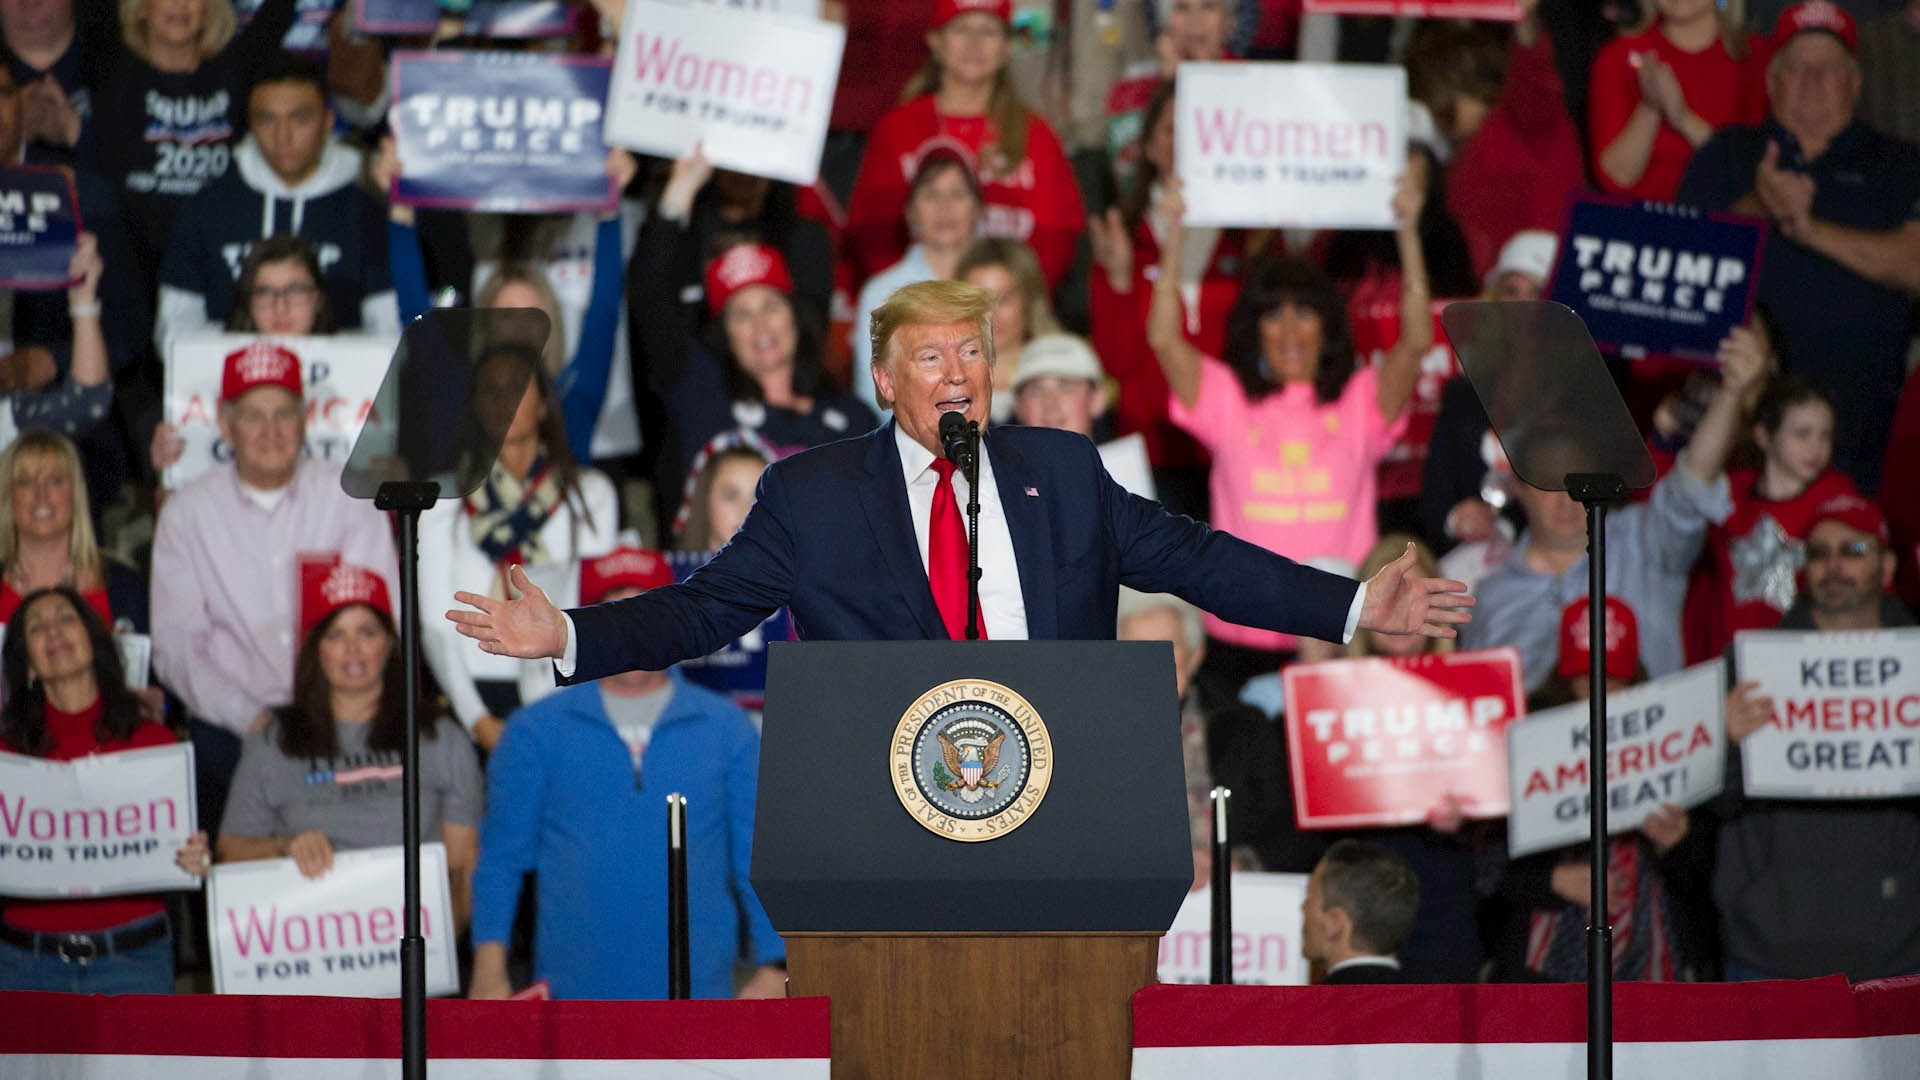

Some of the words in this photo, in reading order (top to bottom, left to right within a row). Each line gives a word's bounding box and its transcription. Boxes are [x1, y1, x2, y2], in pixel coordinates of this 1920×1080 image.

[635, 32, 813, 114] Women
[408, 92, 601, 129] TRUMP
[427, 128, 582, 153] PENCE
[1194, 106, 1389, 161] Women
[155, 142, 229, 178] 2020
[1573, 235, 1746, 291] TRUMP
[1579, 269, 1724, 313] PENCE
[1801, 657, 1901, 688] KEEP
[972, 687, 988, 697] OF
[990, 690, 1010, 706] THE
[896, 685, 967, 757] PRESIDENT
[1306, 696, 1505, 741] TRUMP
[1014, 704, 1047, 770] UNITED
[1327, 731, 1488, 764] PENCE
[898, 762, 910, 784] THE
[904, 786, 917, 801] OF
[985, 784, 1040, 834] STATES
[1555, 768, 1688, 822] GEAT!
[917, 800, 957, 833] SEAL
[64, 839, 160, 862] TRUMP
[256, 960, 311, 981] FOR
[322, 951, 398, 975] TRUM
